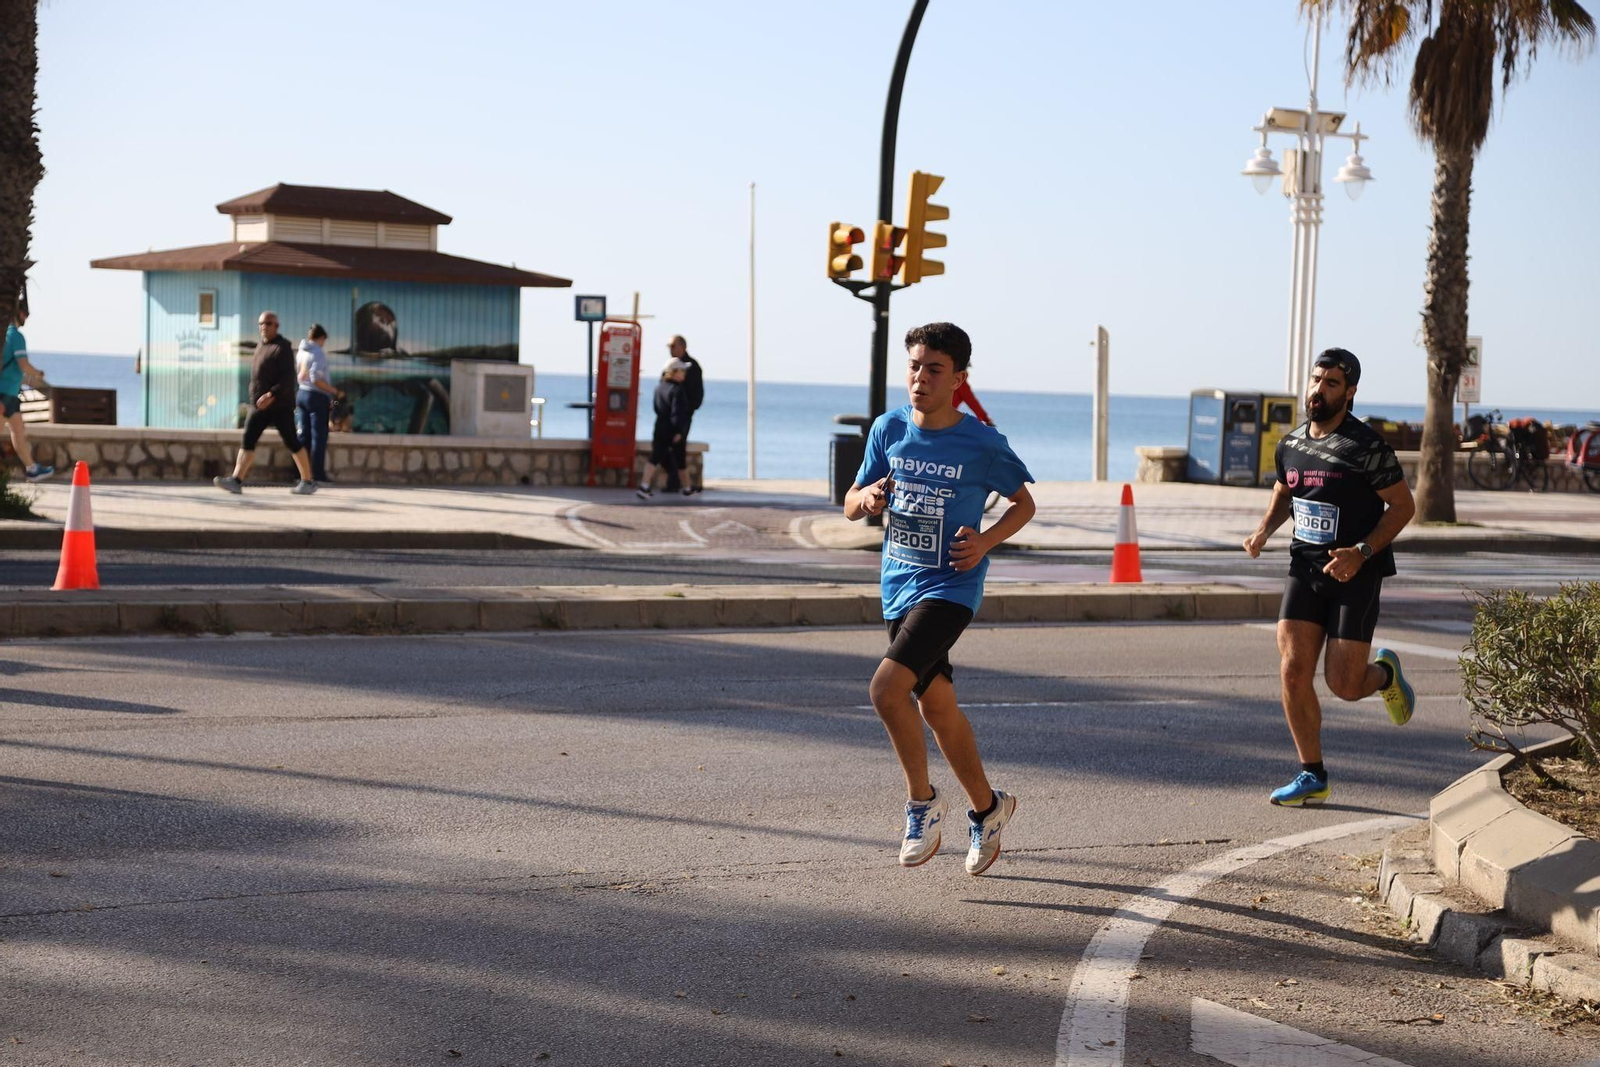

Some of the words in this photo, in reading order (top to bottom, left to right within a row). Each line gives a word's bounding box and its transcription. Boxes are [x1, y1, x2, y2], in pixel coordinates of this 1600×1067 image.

[890, 456, 963, 480] mayoral
[1303, 477, 1324, 487] GIRONA
[894, 490, 945, 507] MAKES
[894, 498, 945, 516] FRIENDS
[1298, 514, 1331, 531] 2060
[892, 528, 933, 550] 2209
